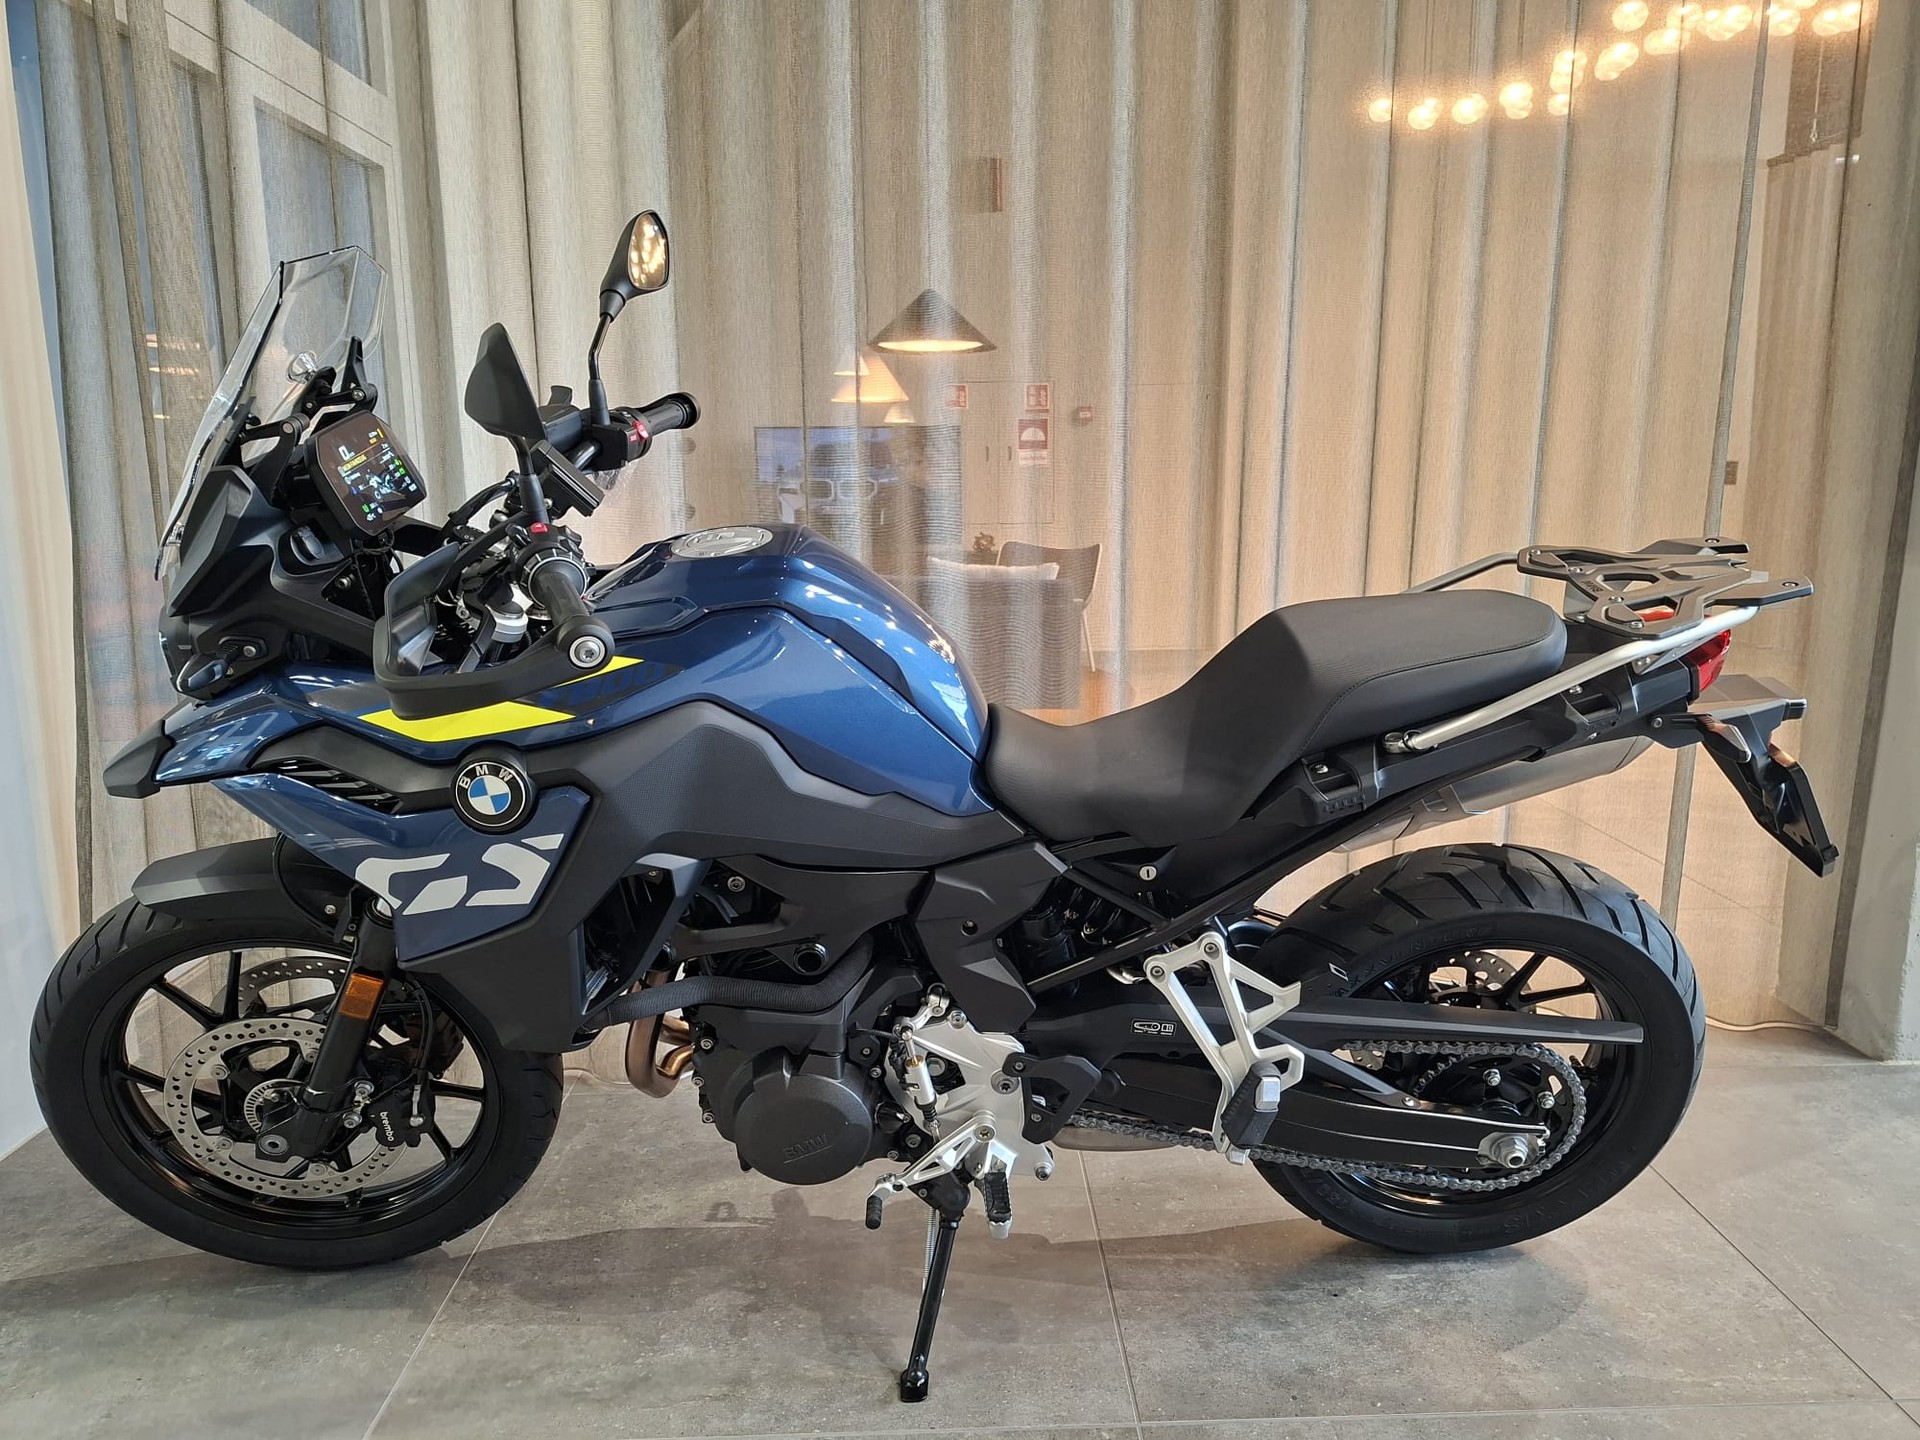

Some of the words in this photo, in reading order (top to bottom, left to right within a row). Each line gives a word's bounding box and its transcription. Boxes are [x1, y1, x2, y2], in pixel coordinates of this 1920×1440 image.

[459, 764, 514, 790] BMW
[355, 833, 565, 916] GS
[380, 1111, 395, 1142] brembo
